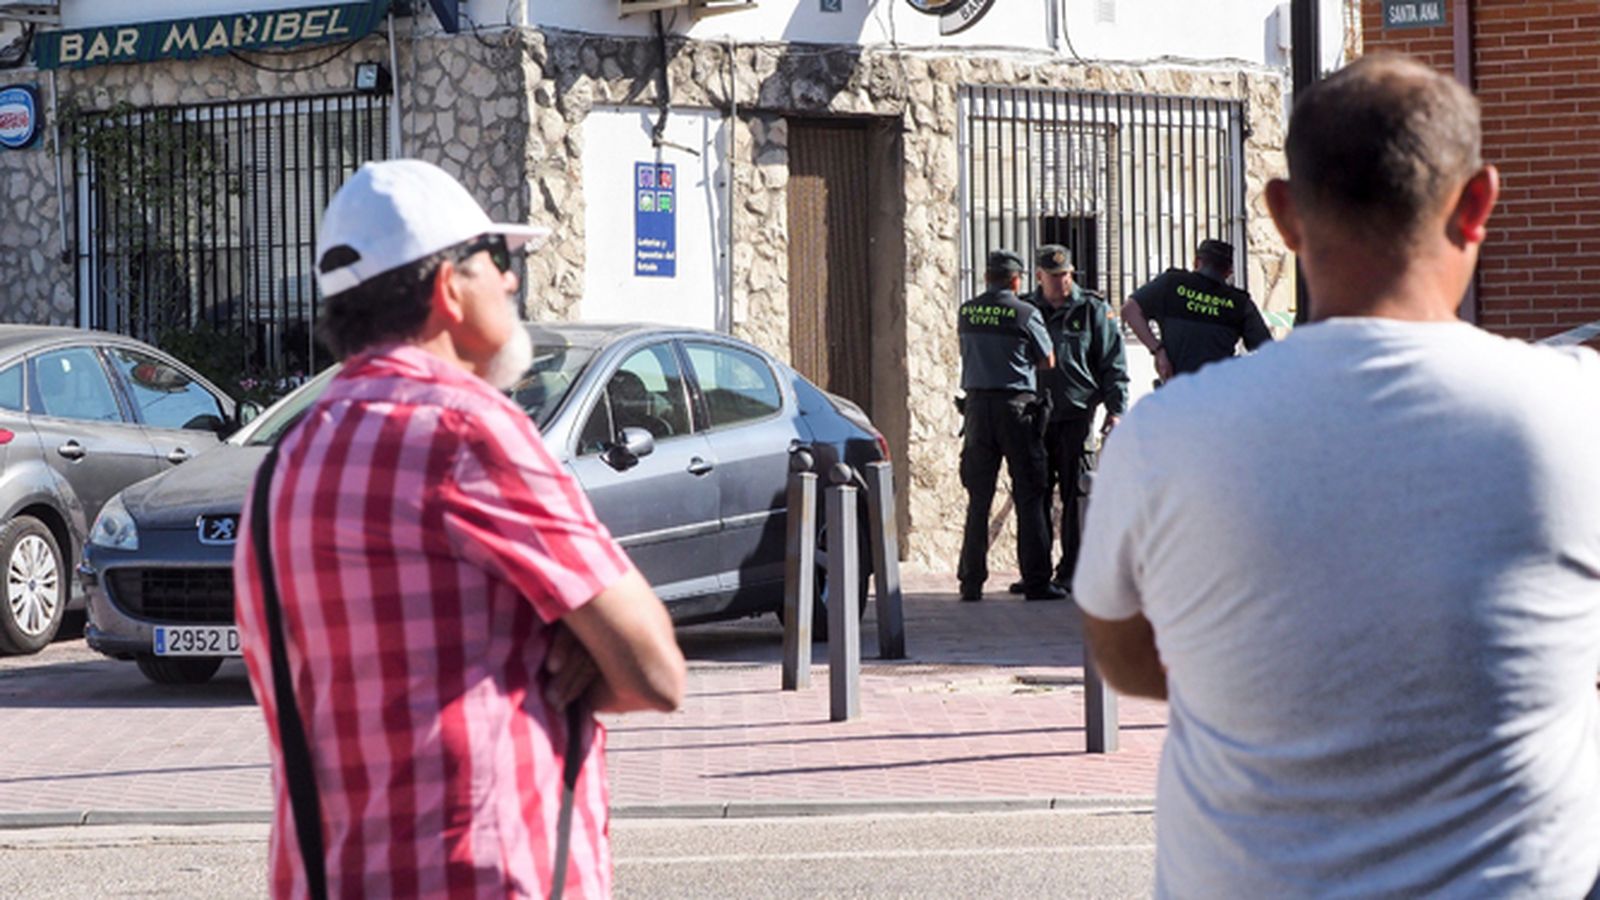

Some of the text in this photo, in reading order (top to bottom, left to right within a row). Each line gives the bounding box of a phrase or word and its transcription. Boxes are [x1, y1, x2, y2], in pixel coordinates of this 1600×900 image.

[1389, 2, 1440, 24] SANTA ANA
[58, 8, 350, 63] BAR MARIBEL
[1176, 284, 1235, 309] GUARDIA
[961, 304, 1017, 318] GUARDIA
[1186, 300, 1220, 316] CIVIL
[969, 314, 1000, 326] CIVIL
[169, 629, 220, 652] 2952
